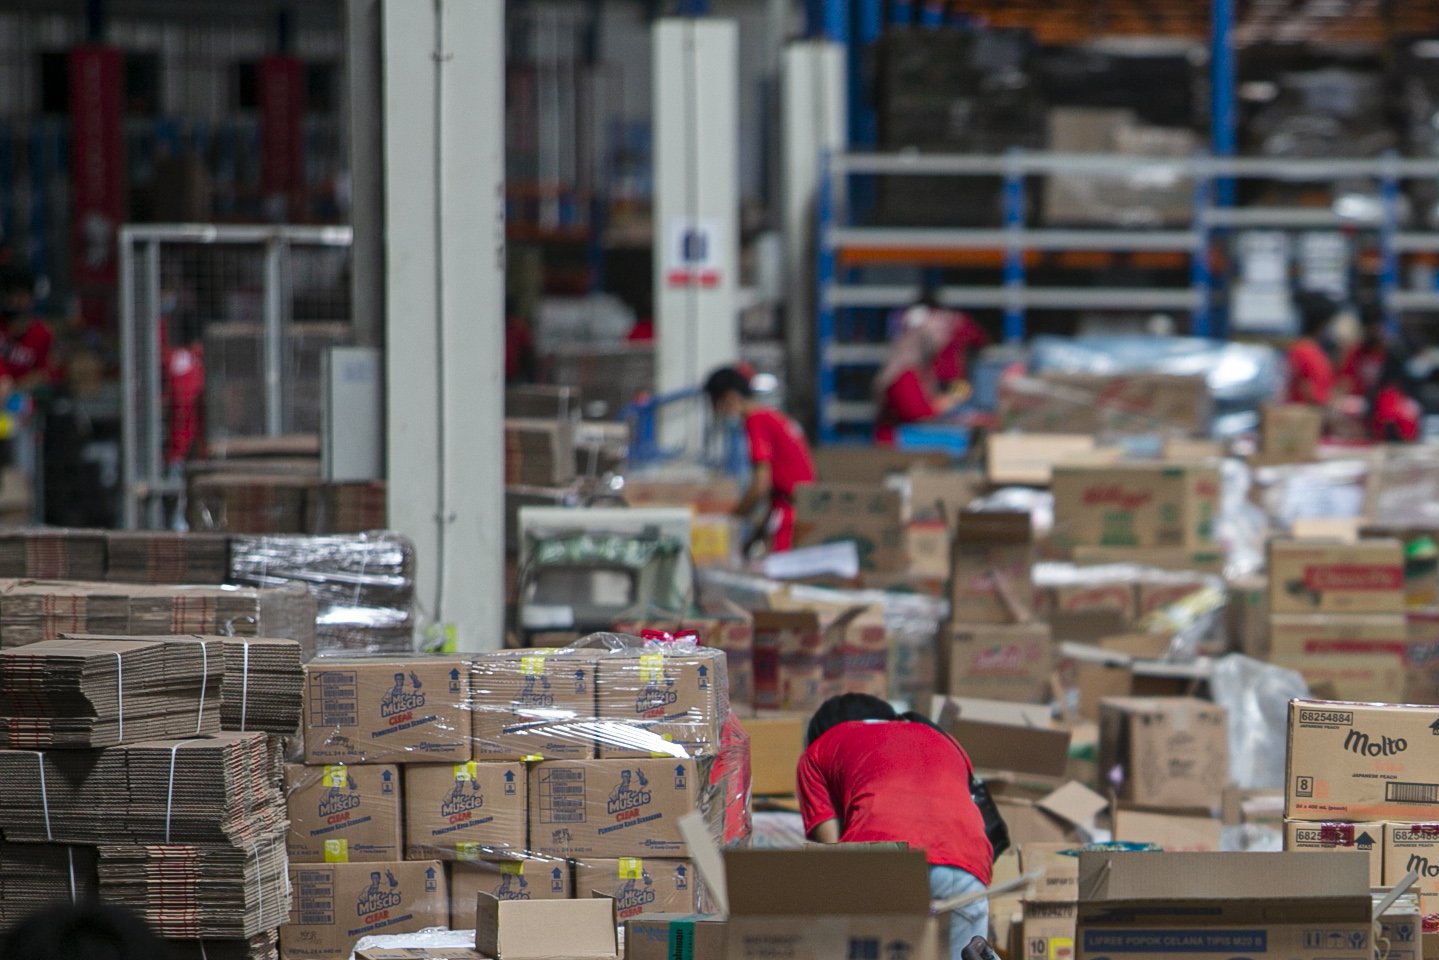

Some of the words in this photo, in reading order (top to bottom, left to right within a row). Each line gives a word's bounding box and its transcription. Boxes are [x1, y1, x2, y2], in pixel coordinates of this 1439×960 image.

[381, 695, 426, 717] Muscle
[1302, 713, 1350, 723] 68254884
[1344, 729, 1408, 757] Molto
[1300, 780, 1308, 790] 8
[319, 795, 361, 817] Muscle
[441, 795, 484, 817] Muscle
[608, 791, 650, 814] Muscle
[616, 809, 640, 822] CLEAR
[357, 893, 402, 916] Muscle
[365, 910, 390, 925] CLEAR
[1031, 940, 1046, 954] 10
[1089, 937, 1124, 946] LIFREE
[1126, 937, 1162, 946] POPOK
[1163, 937, 1204, 946] CELANA
[1206, 937, 1232, 946] TIPIS
